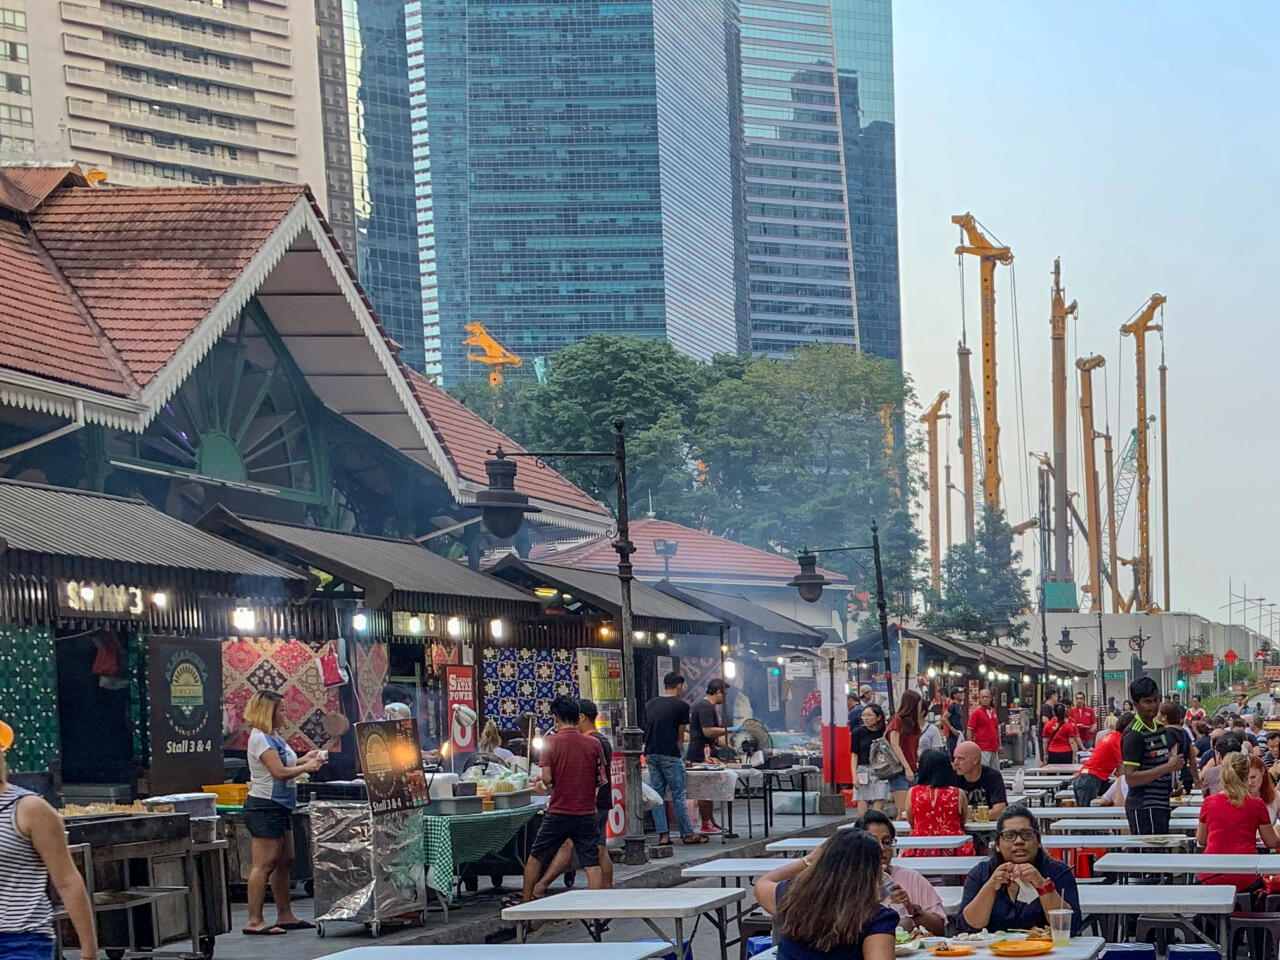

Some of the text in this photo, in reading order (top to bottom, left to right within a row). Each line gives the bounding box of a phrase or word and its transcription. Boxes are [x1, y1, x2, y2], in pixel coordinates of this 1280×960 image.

[128, 586, 143, 613] 3
[429, 613, 436, 632] 6
[449, 691, 473, 701] POWER
[166, 740, 212, 754] Stall 3 & 4
[372, 800, 387, 813] Stall
[387, 799, 392, 810] 3
[397, 797, 402, 808] 4
[608, 788, 625, 834] 6
